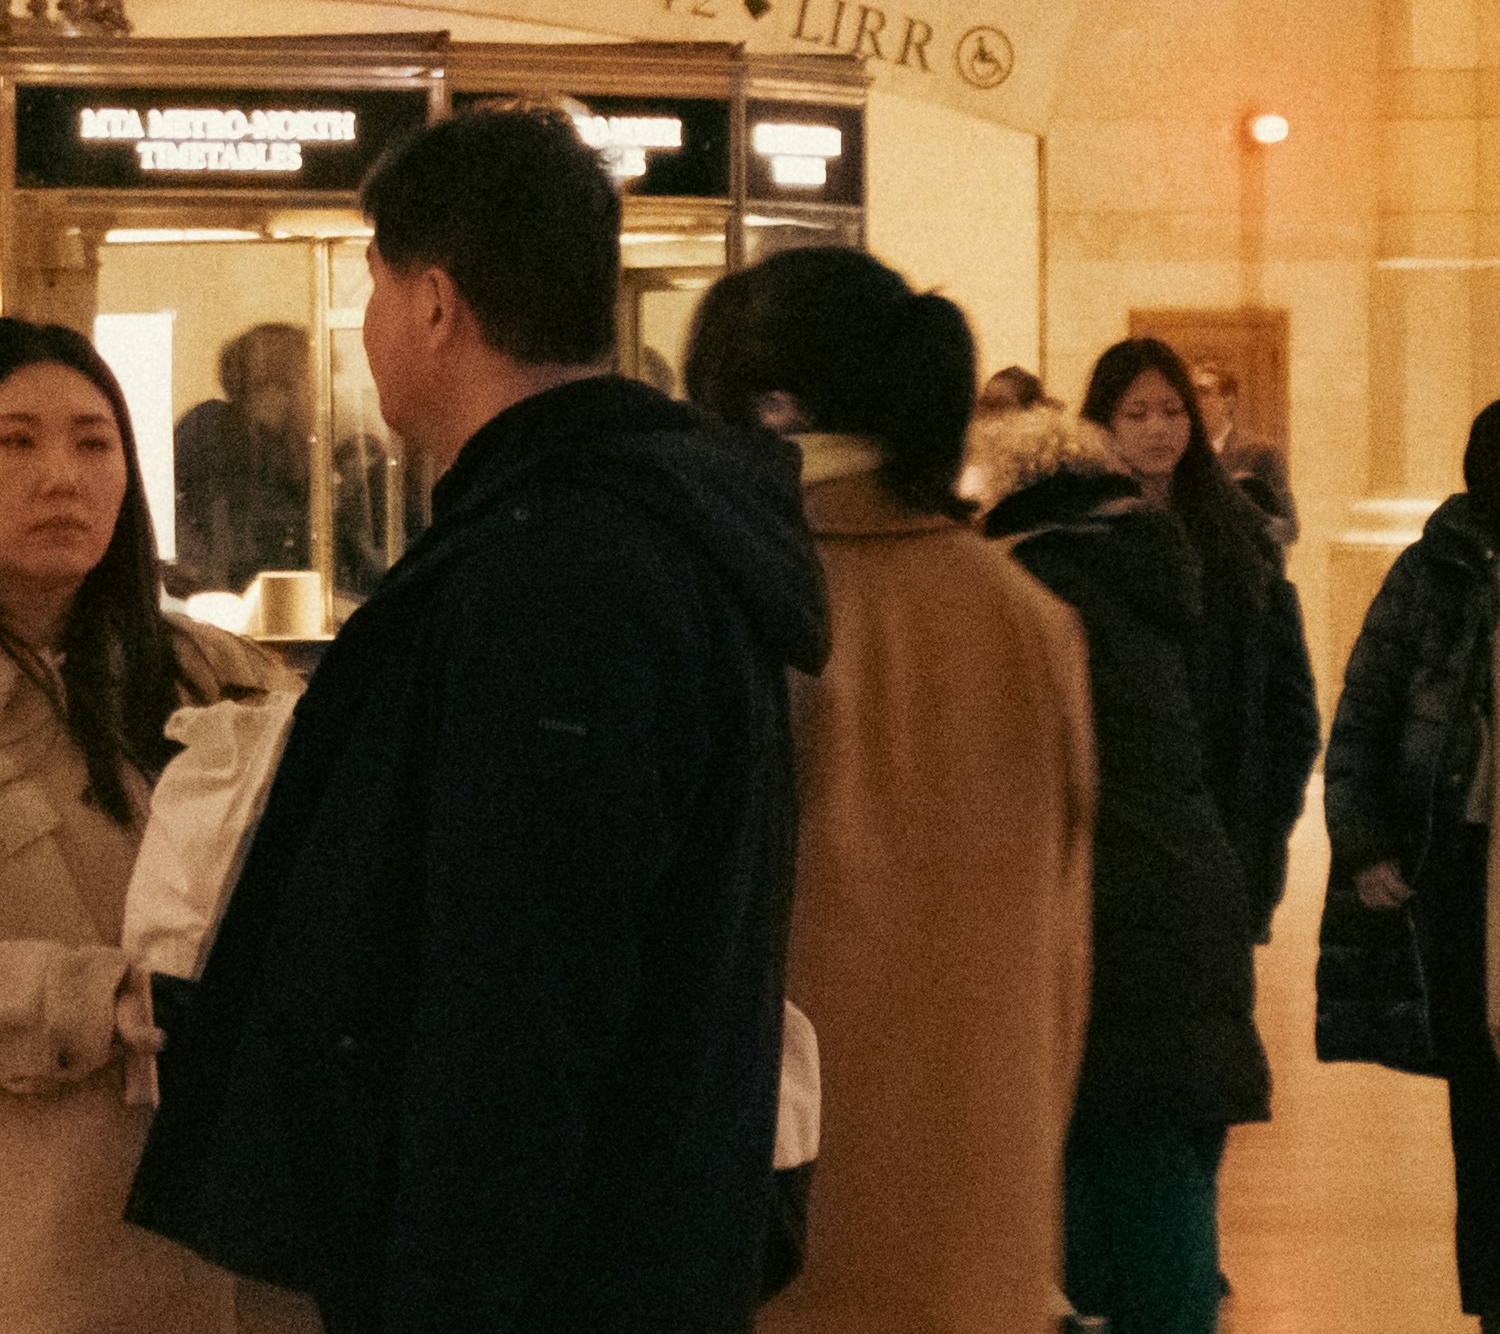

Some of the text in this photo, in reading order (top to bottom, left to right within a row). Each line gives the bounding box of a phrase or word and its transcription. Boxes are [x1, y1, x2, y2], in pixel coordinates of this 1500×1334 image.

[80, 108, 356, 141] MTA METRO-NORTH
[136, 141, 302, 171] TIMETABLES
